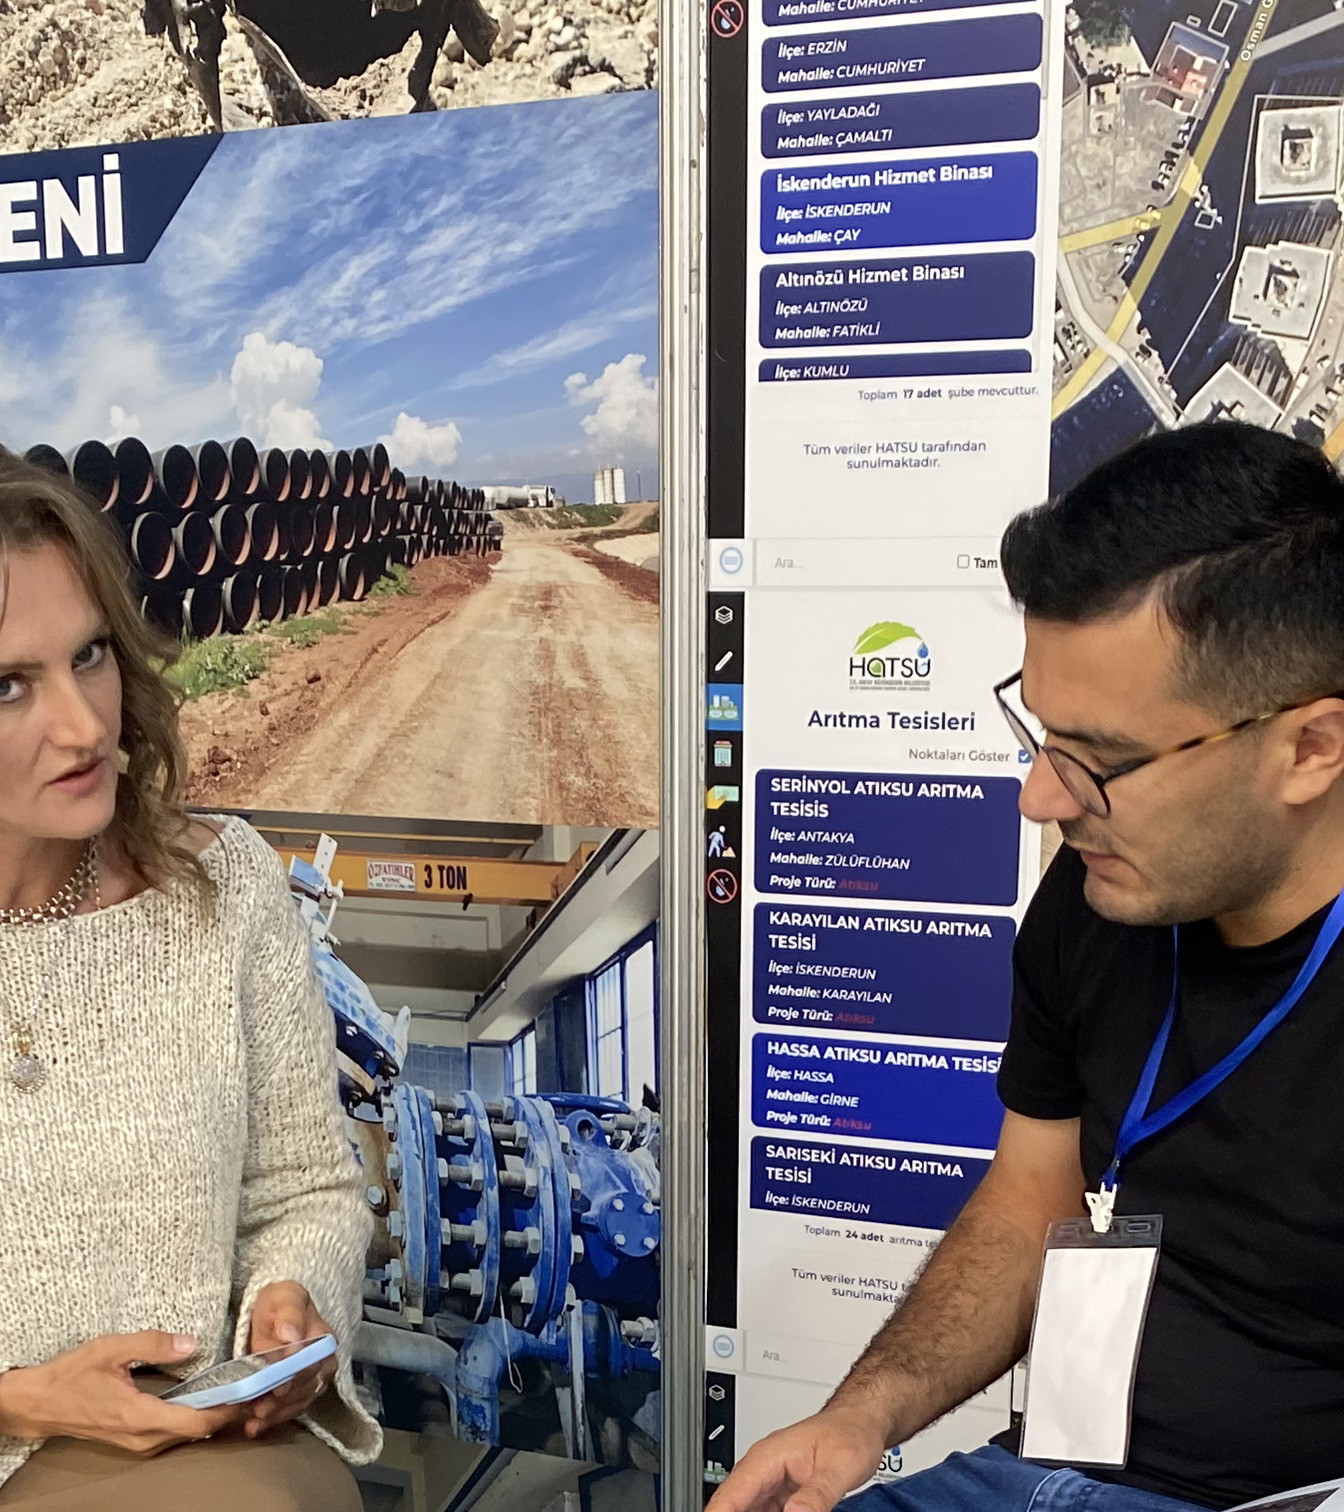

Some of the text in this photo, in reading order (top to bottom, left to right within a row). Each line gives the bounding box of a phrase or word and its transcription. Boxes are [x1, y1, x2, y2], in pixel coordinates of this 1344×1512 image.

[1240, 13, 1268, 61] Osman
[778, 39, 847, 59] İlçe: ERZİN
[778, 59, 926, 83] Mahalle: CUMHURİYET
[777, 104, 880, 126] İlçe: YAYLADAĞI
[777, 129, 893, 149] Mahalle: ÇAMALTI
[777, 165, 993, 192] İskenderun Hizmet Binası
[777, 202, 891, 223] İlçe: İSKENDERUN
[776, 229, 860, 245] Mahalle: ÇAY
[776, 265, 965, 288] Altınözü Hizmet Binası
[776, 298, 868, 317] İlçe: ALTINÖZÜ
[775, 322, 880, 340] Mahalle: FATİKLİ
[775, 364, 849, 381] İlçe: KUMLU
[858, 386, 1039, 401] Toplam 17 adet şube mevcuttur.
[804, 441, 986, 455] Tüm veriler HATSU tarafından
[847, 456, 940, 469] sunulmaktadır.
[974, 557, 998, 569] Tam
[808, 709, 975, 731] Arıtma Tesisleri
[909, 749, 1010, 763] Noktaları Göster
[771, 776, 984, 799] SERİNYOL ATIKSU ARITMA
[771, 800, 829, 818] TESİSİS
[770, 827, 855, 844] İlçe: ANTAKYA
[770, 852, 910, 870] Mahalle: ZÜLÜFLÜHAN
[424, 864, 432, 888] 3
[438, 865, 467, 890] TON
[769, 876, 836, 890] Proje Türü:
[769, 911, 992, 938] KARAYILAN ATIKSU ARITMA
[768, 934, 816, 951] TESİSİ
[768, 1041, 820, 1059] HASSA
[824, 1047, 881, 1064] ATIKSU
[884, 1054, 948, 1070] ARITMA
[766, 1144, 964, 1178] SARISEKİ ATIKSU ARITMA
[765, 1165, 812, 1184] TESİSİ
